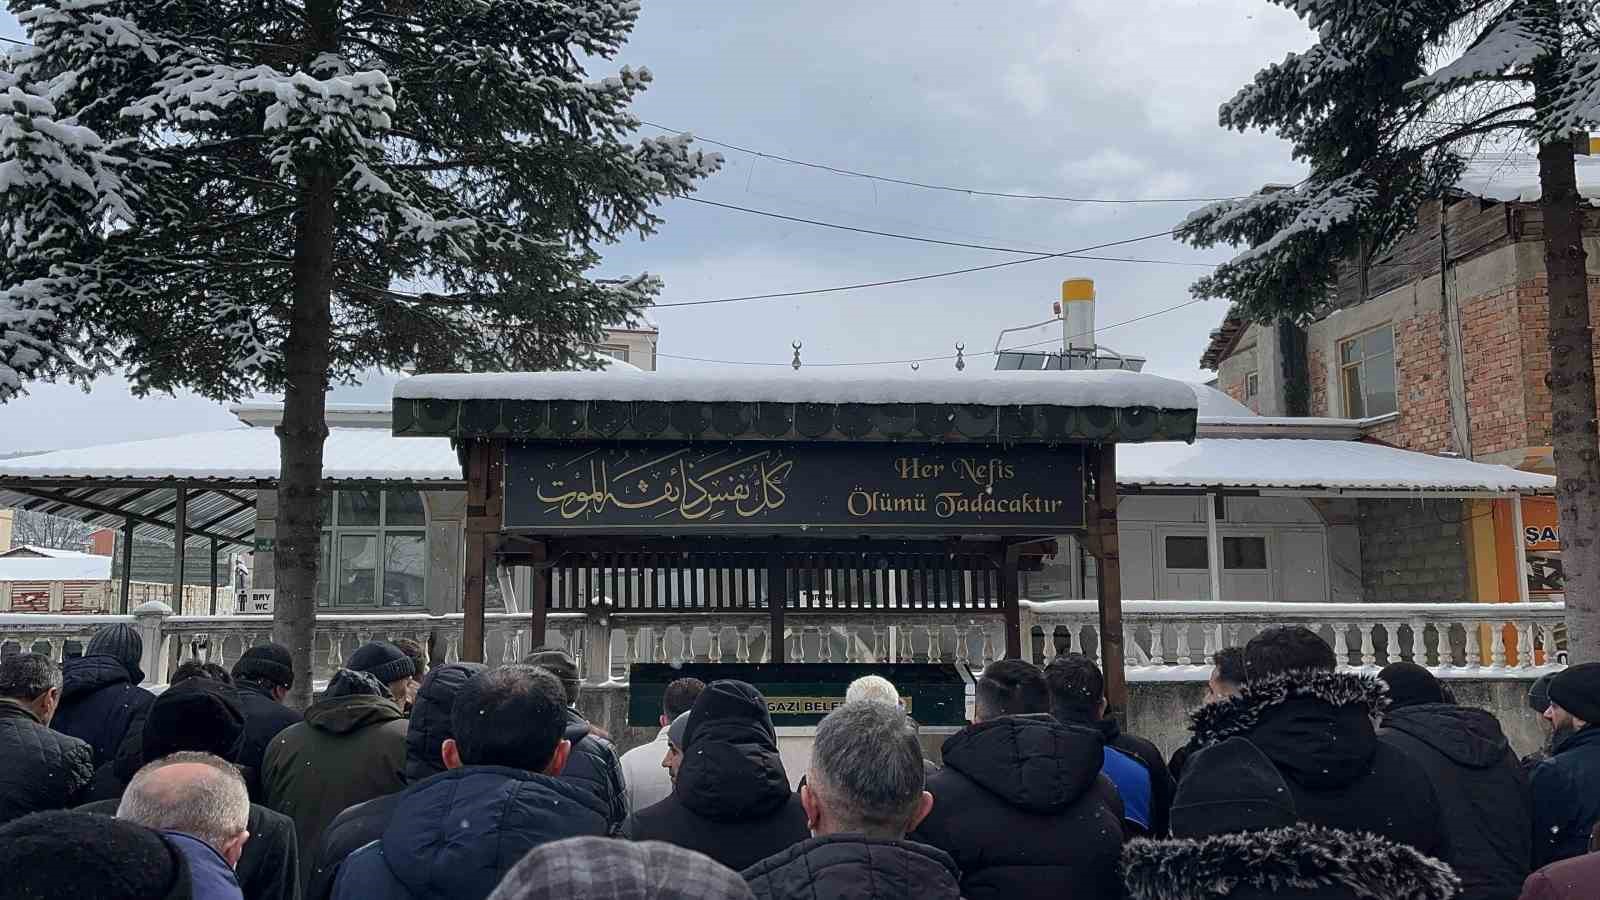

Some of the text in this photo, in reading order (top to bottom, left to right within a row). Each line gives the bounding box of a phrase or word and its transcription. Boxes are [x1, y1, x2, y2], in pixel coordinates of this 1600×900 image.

[895, 458, 1015, 485] Her Nefis
[848, 484, 1063, 518] Ölümü Tadacaktır
[1525, 526, 1560, 545] ŞA
[252, 593, 271, 601] BAY
